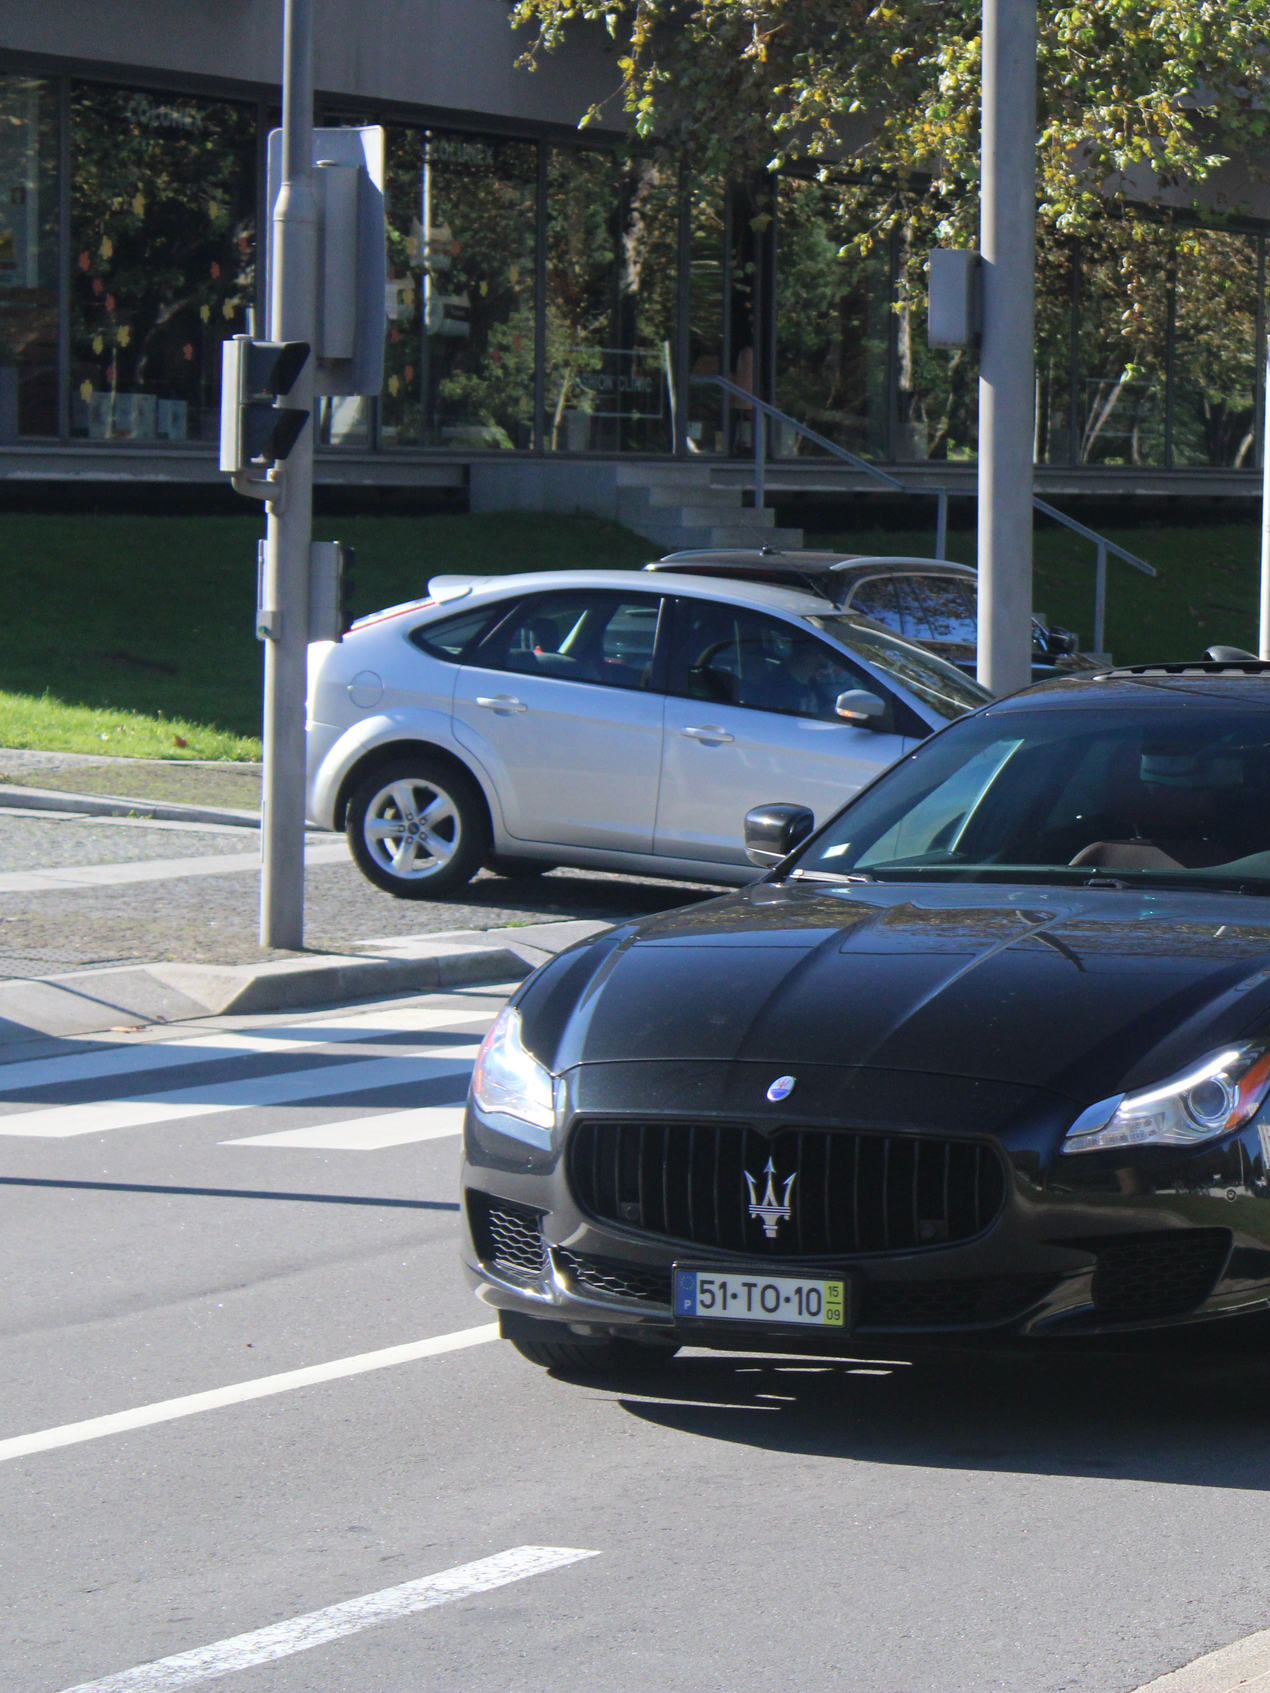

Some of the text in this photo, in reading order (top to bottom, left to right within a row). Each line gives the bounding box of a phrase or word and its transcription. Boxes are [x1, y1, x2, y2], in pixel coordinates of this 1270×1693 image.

[827, 1285, 840, 1298] 15
[684, 1299, 692, 1310] P
[826, 1308, 841, 1321] 09
